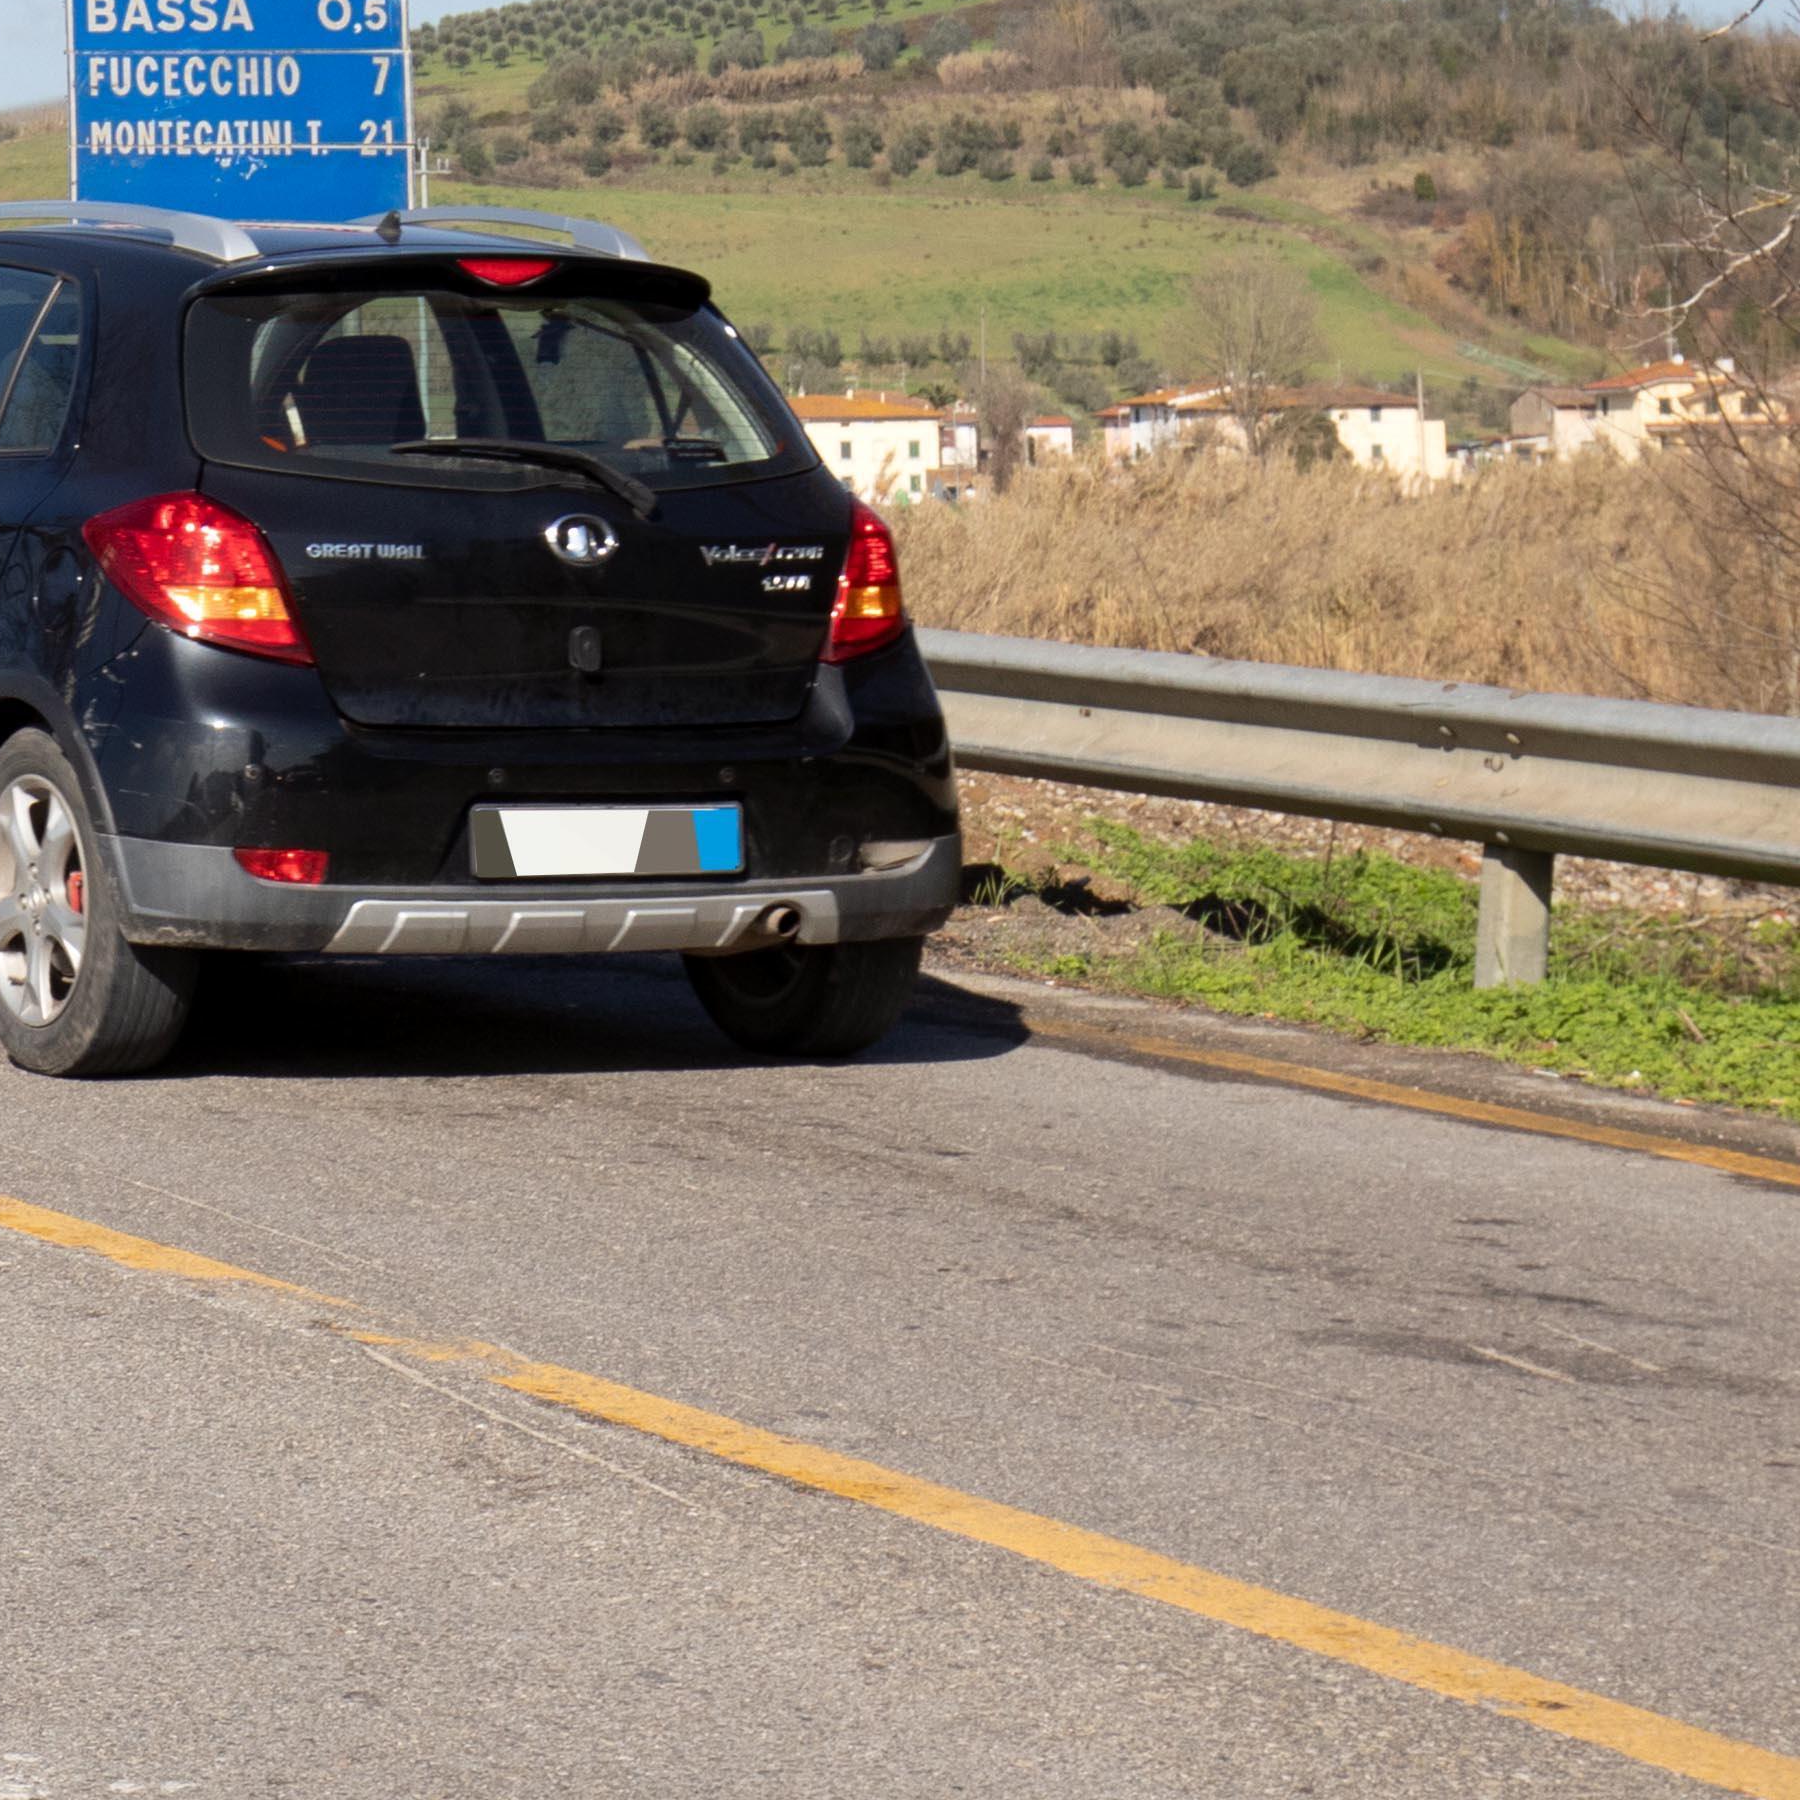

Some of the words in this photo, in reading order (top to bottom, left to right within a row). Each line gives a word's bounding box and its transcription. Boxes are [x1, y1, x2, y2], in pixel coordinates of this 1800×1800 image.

[89, 56, 301, 96] FUCECCHIO
[371, 56, 391, 96] 7
[90, 120, 293, 156] MONTECATINI
[305, 120, 329, 156] T.
[359, 120, 394, 156] 21
[305, 543, 374, 559] GREAT
[376, 544, 426, 560] WALL
